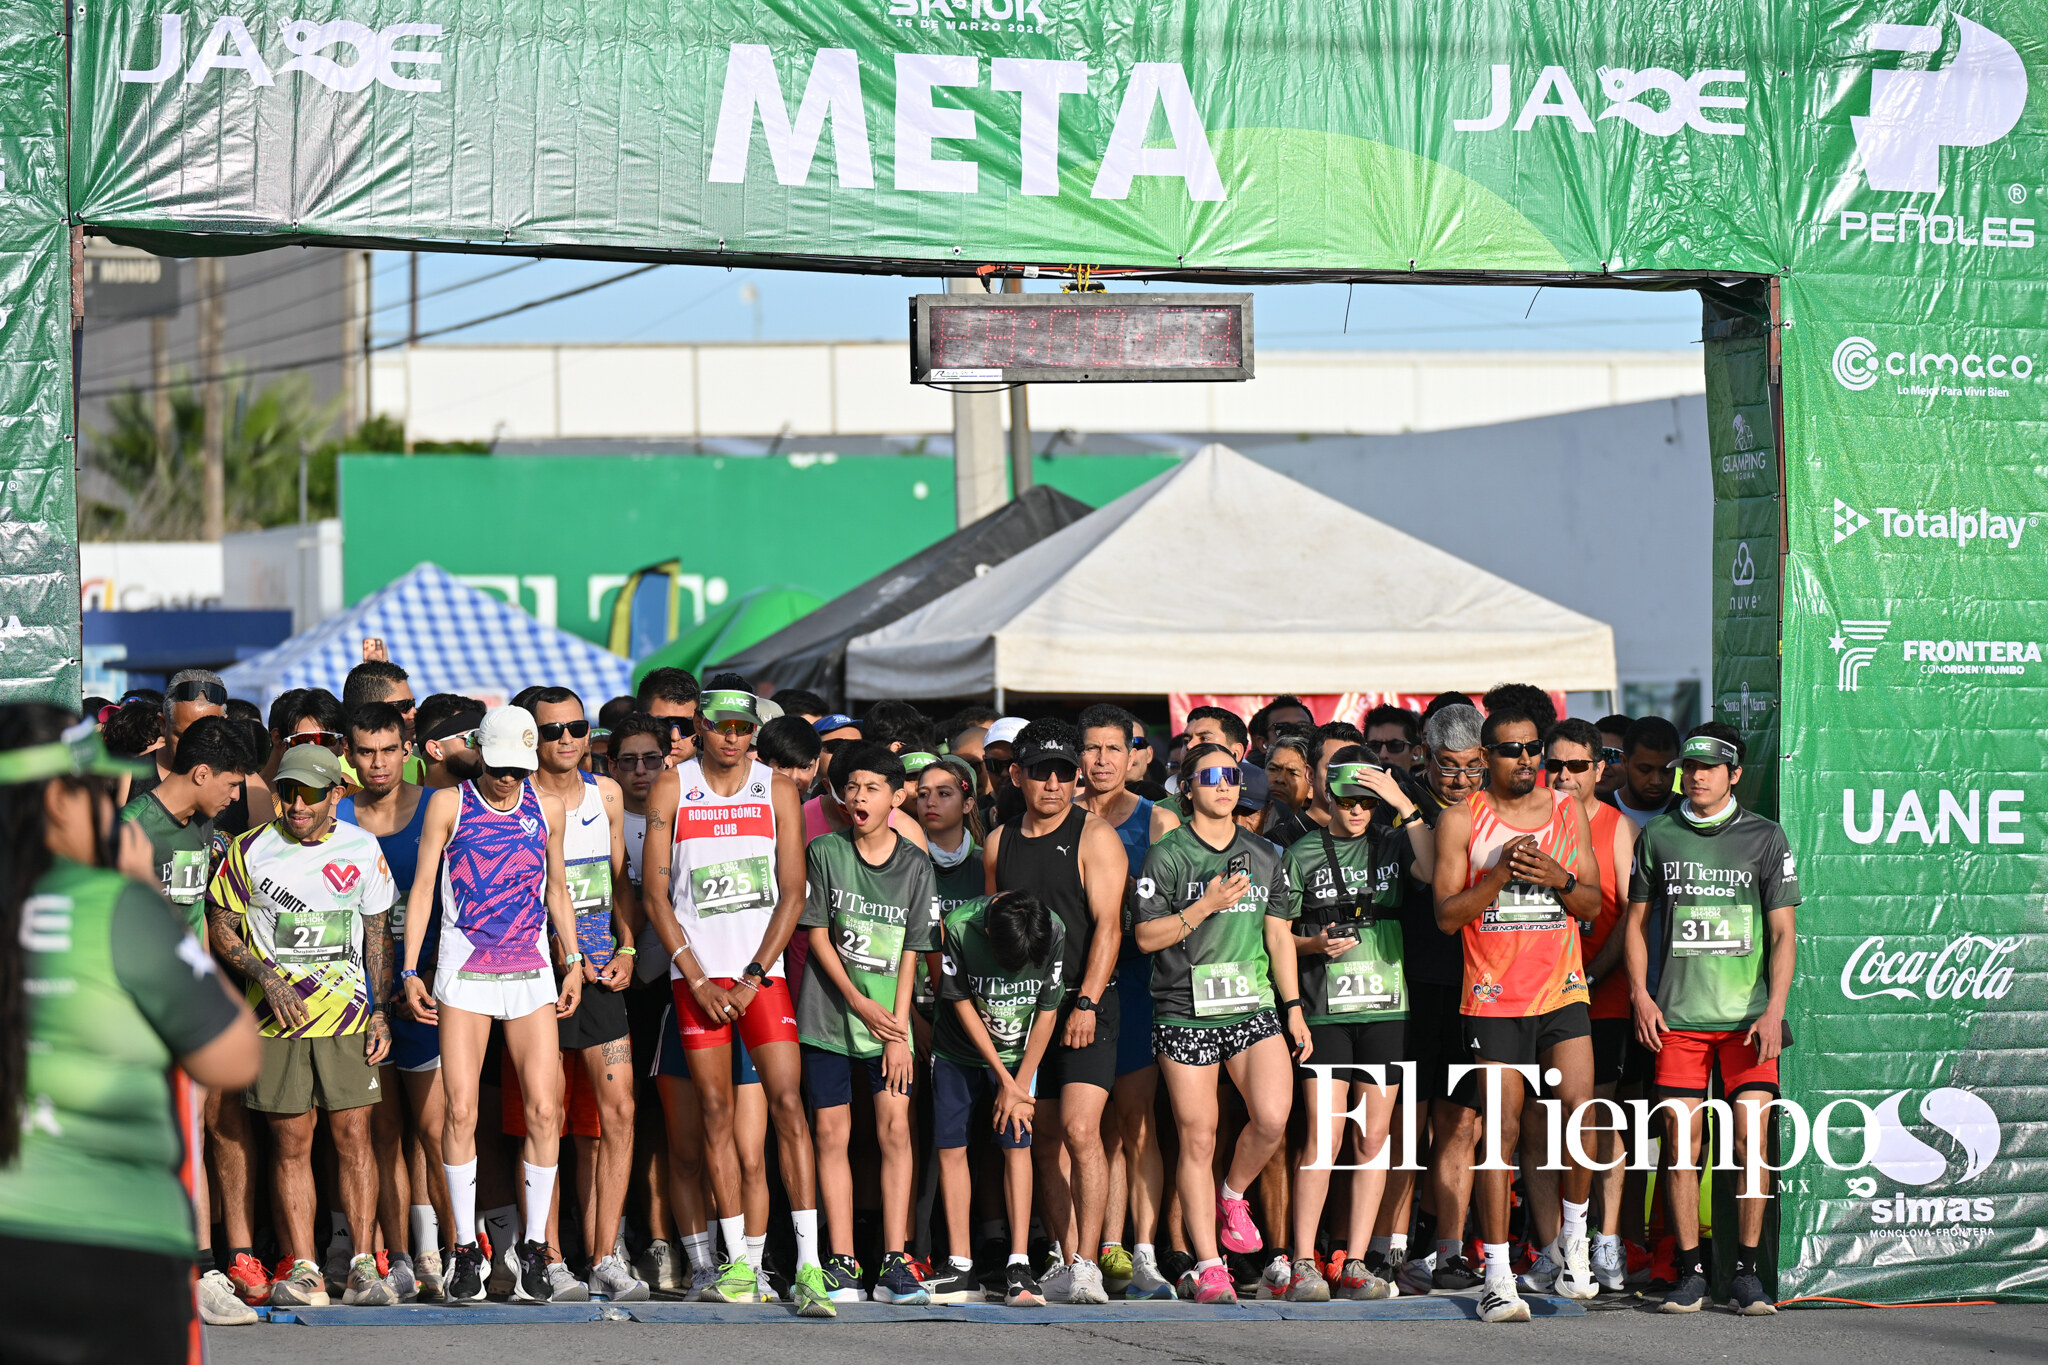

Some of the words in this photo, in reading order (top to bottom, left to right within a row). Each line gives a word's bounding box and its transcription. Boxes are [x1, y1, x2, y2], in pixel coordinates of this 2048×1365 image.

[896, 18, 913, 28] 15
[920, 20, 939, 30] DE
[946, 21, 1001, 32] MARZO
[1008, 24, 1043, 34] 2026
[708, 43, 1227, 202] META
[1840, 207, 2035, 248] PEÑOLES
[1897, 384, 1909, 395] Lo
[1911, 385, 1939, 398] Mejor
[1941, 386, 1962, 397] Para
[1964, 386, 1987, 397] Vivir
[1988, 387, 2009, 398] Bien
[1722, 452, 1766, 473] GLAMPING
[1729, 595, 1757, 610] nuve
[1903, 640, 2043, 662] FRONTERA
[1920, 664, 2025, 675] CONORDENYRUMBO
[1723, 699, 1740, 712] Santa
[688, 808, 729, 821] RODOLFO
[730, 805, 762, 820] GÓMEZ
[1843, 788, 2025, 844] UANE
[713, 823, 738, 836] CLUB
[761, 867, 770, 901] MEDALLA
[1314, 867, 1334, 887] El
[1662, 861, 1680, 882] El
[1683, 861, 1752, 887] Tiempo
[259, 877, 274, 895] EL
[602, 872, 610, 907] MEDALLA
[702, 872, 752, 901] 225
[1315, 887, 1338, 899] de
[1667, 883, 1682, 896] de
[1686, 884, 1736, 898] todos
[846, 892, 910, 923] Tiempo
[293, 925, 327, 947] 27
[1480, 924, 1499, 932] CLUB
[1499, 924, 1524, 932] NORA
[1682, 919, 1731, 941] 314
[1743, 916, 1751, 950] MEDALLA
[842, 930, 872, 956] 22
[889, 938, 901, 972] MEDALLA
[1840, 935, 2026, 1001] Coca-Cola
[986, 976, 1043, 996] Tiemp
[1203, 975, 1250, 999] 118
[1336, 973, 1384, 997] 218
[987, 996, 1037, 1008] todos
[980, 1009, 1023, 1034] 236
[1870, 1192, 1995, 1224] simas
[1869, 1227, 1995, 1239] MONCLOVA-FRONTERA
